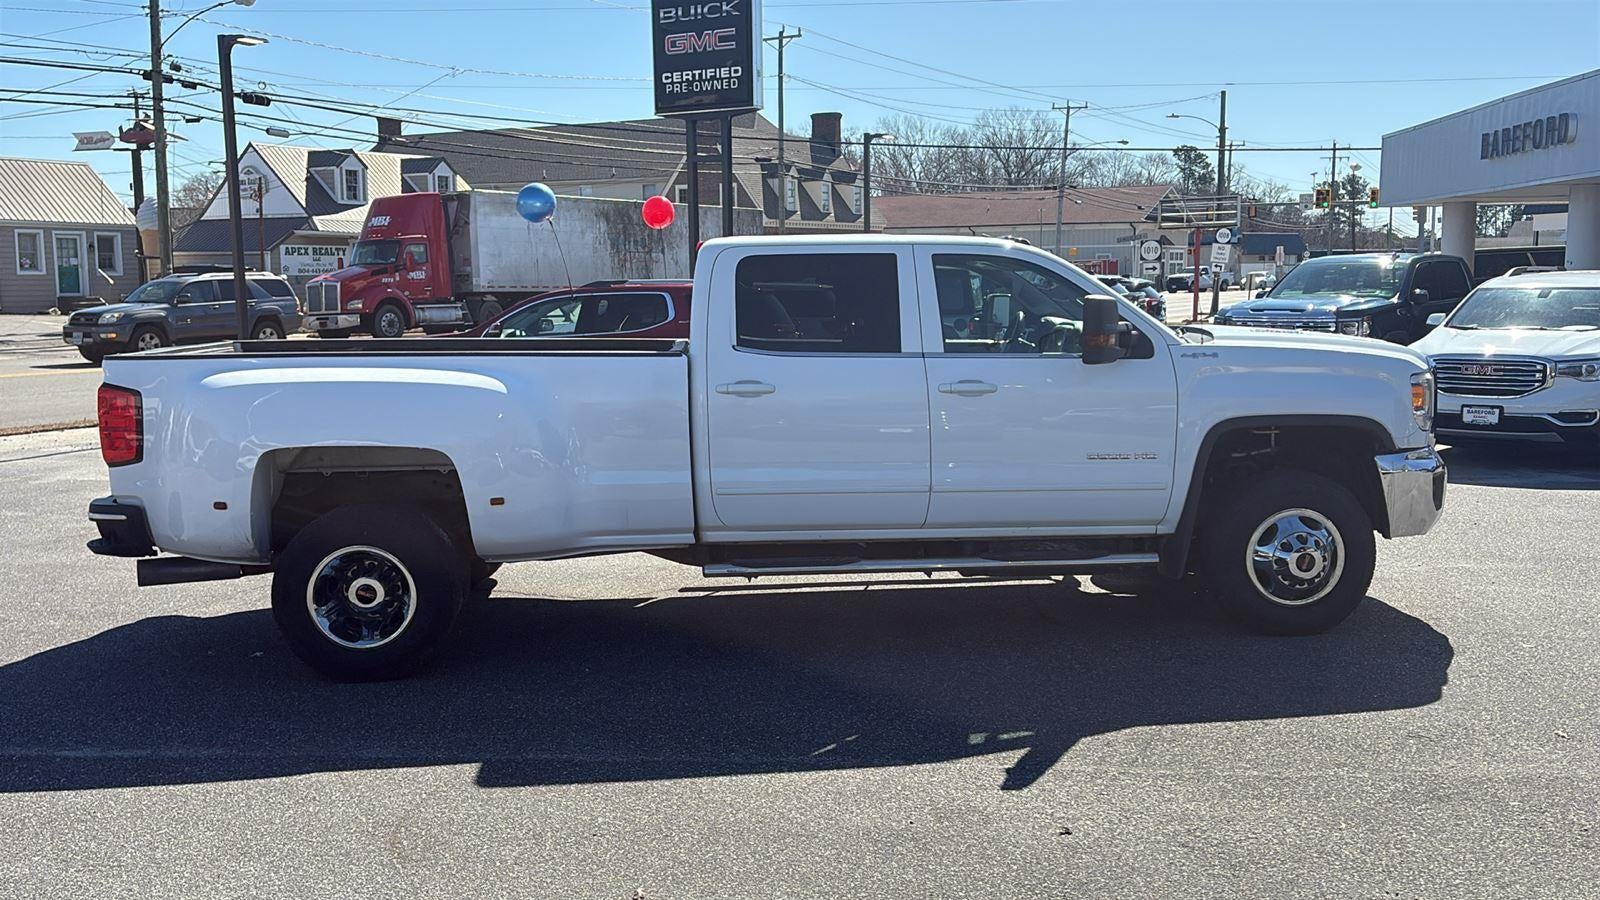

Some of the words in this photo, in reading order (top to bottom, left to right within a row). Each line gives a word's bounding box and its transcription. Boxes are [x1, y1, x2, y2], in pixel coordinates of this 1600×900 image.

[659, 0, 741, 23] BUICK
[665, 27, 736, 55] GMC
[662, 66, 742, 83] CERTIFIED
[666, 78, 738, 94] PRE-OWNED
[1480, 112, 1578, 160] BAREFORD
[285, 246, 309, 256] APEX
[312, 247, 347, 257] REALTY
[1143, 246, 1159, 255] 1010
[1460, 364, 1504, 376] GMC
